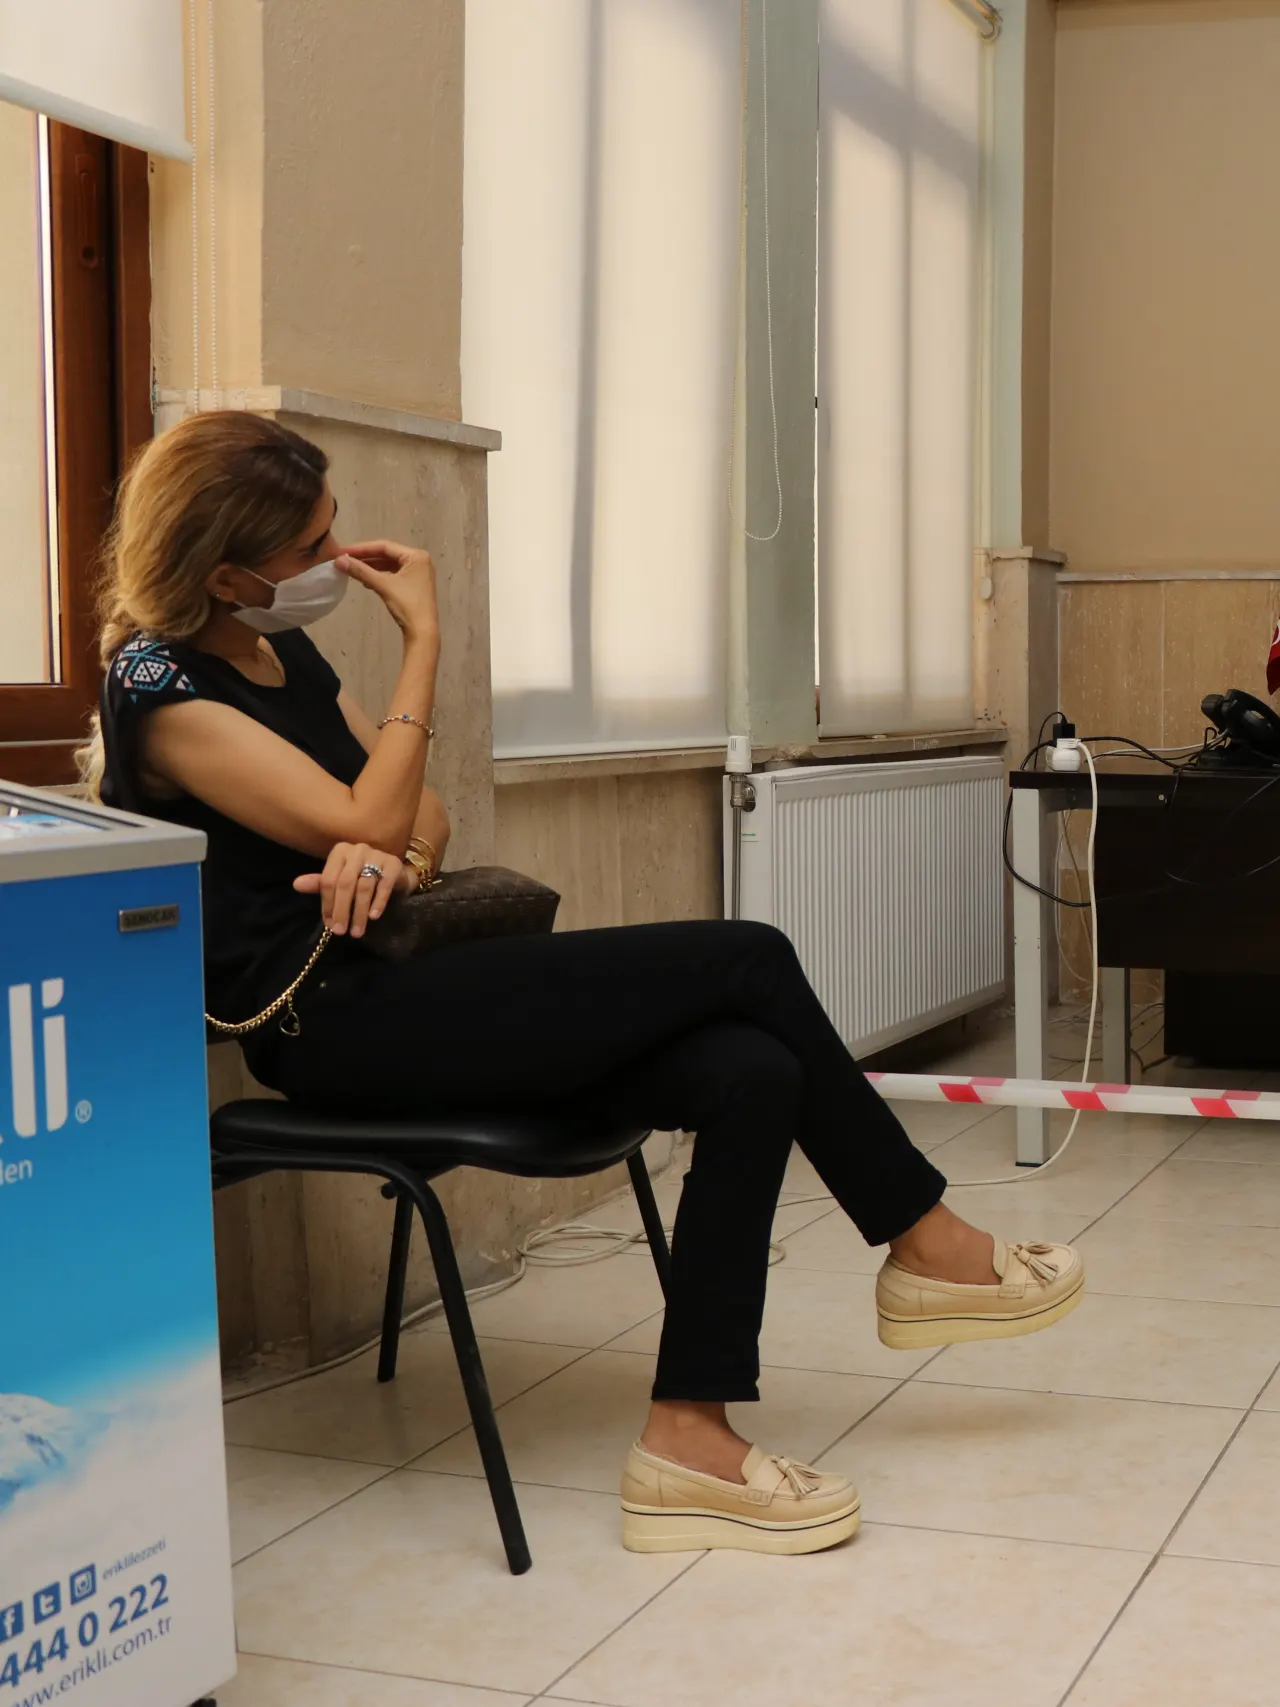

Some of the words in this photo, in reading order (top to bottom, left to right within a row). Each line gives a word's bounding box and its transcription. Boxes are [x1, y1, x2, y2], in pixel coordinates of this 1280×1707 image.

[0, 977, 68, 1144] li
[0, 1159, 33, 1186] en
[0, 1627, 70, 1688] 444
[78, 1611, 99, 1648] 0
[108, 1573, 169, 1633] 222
